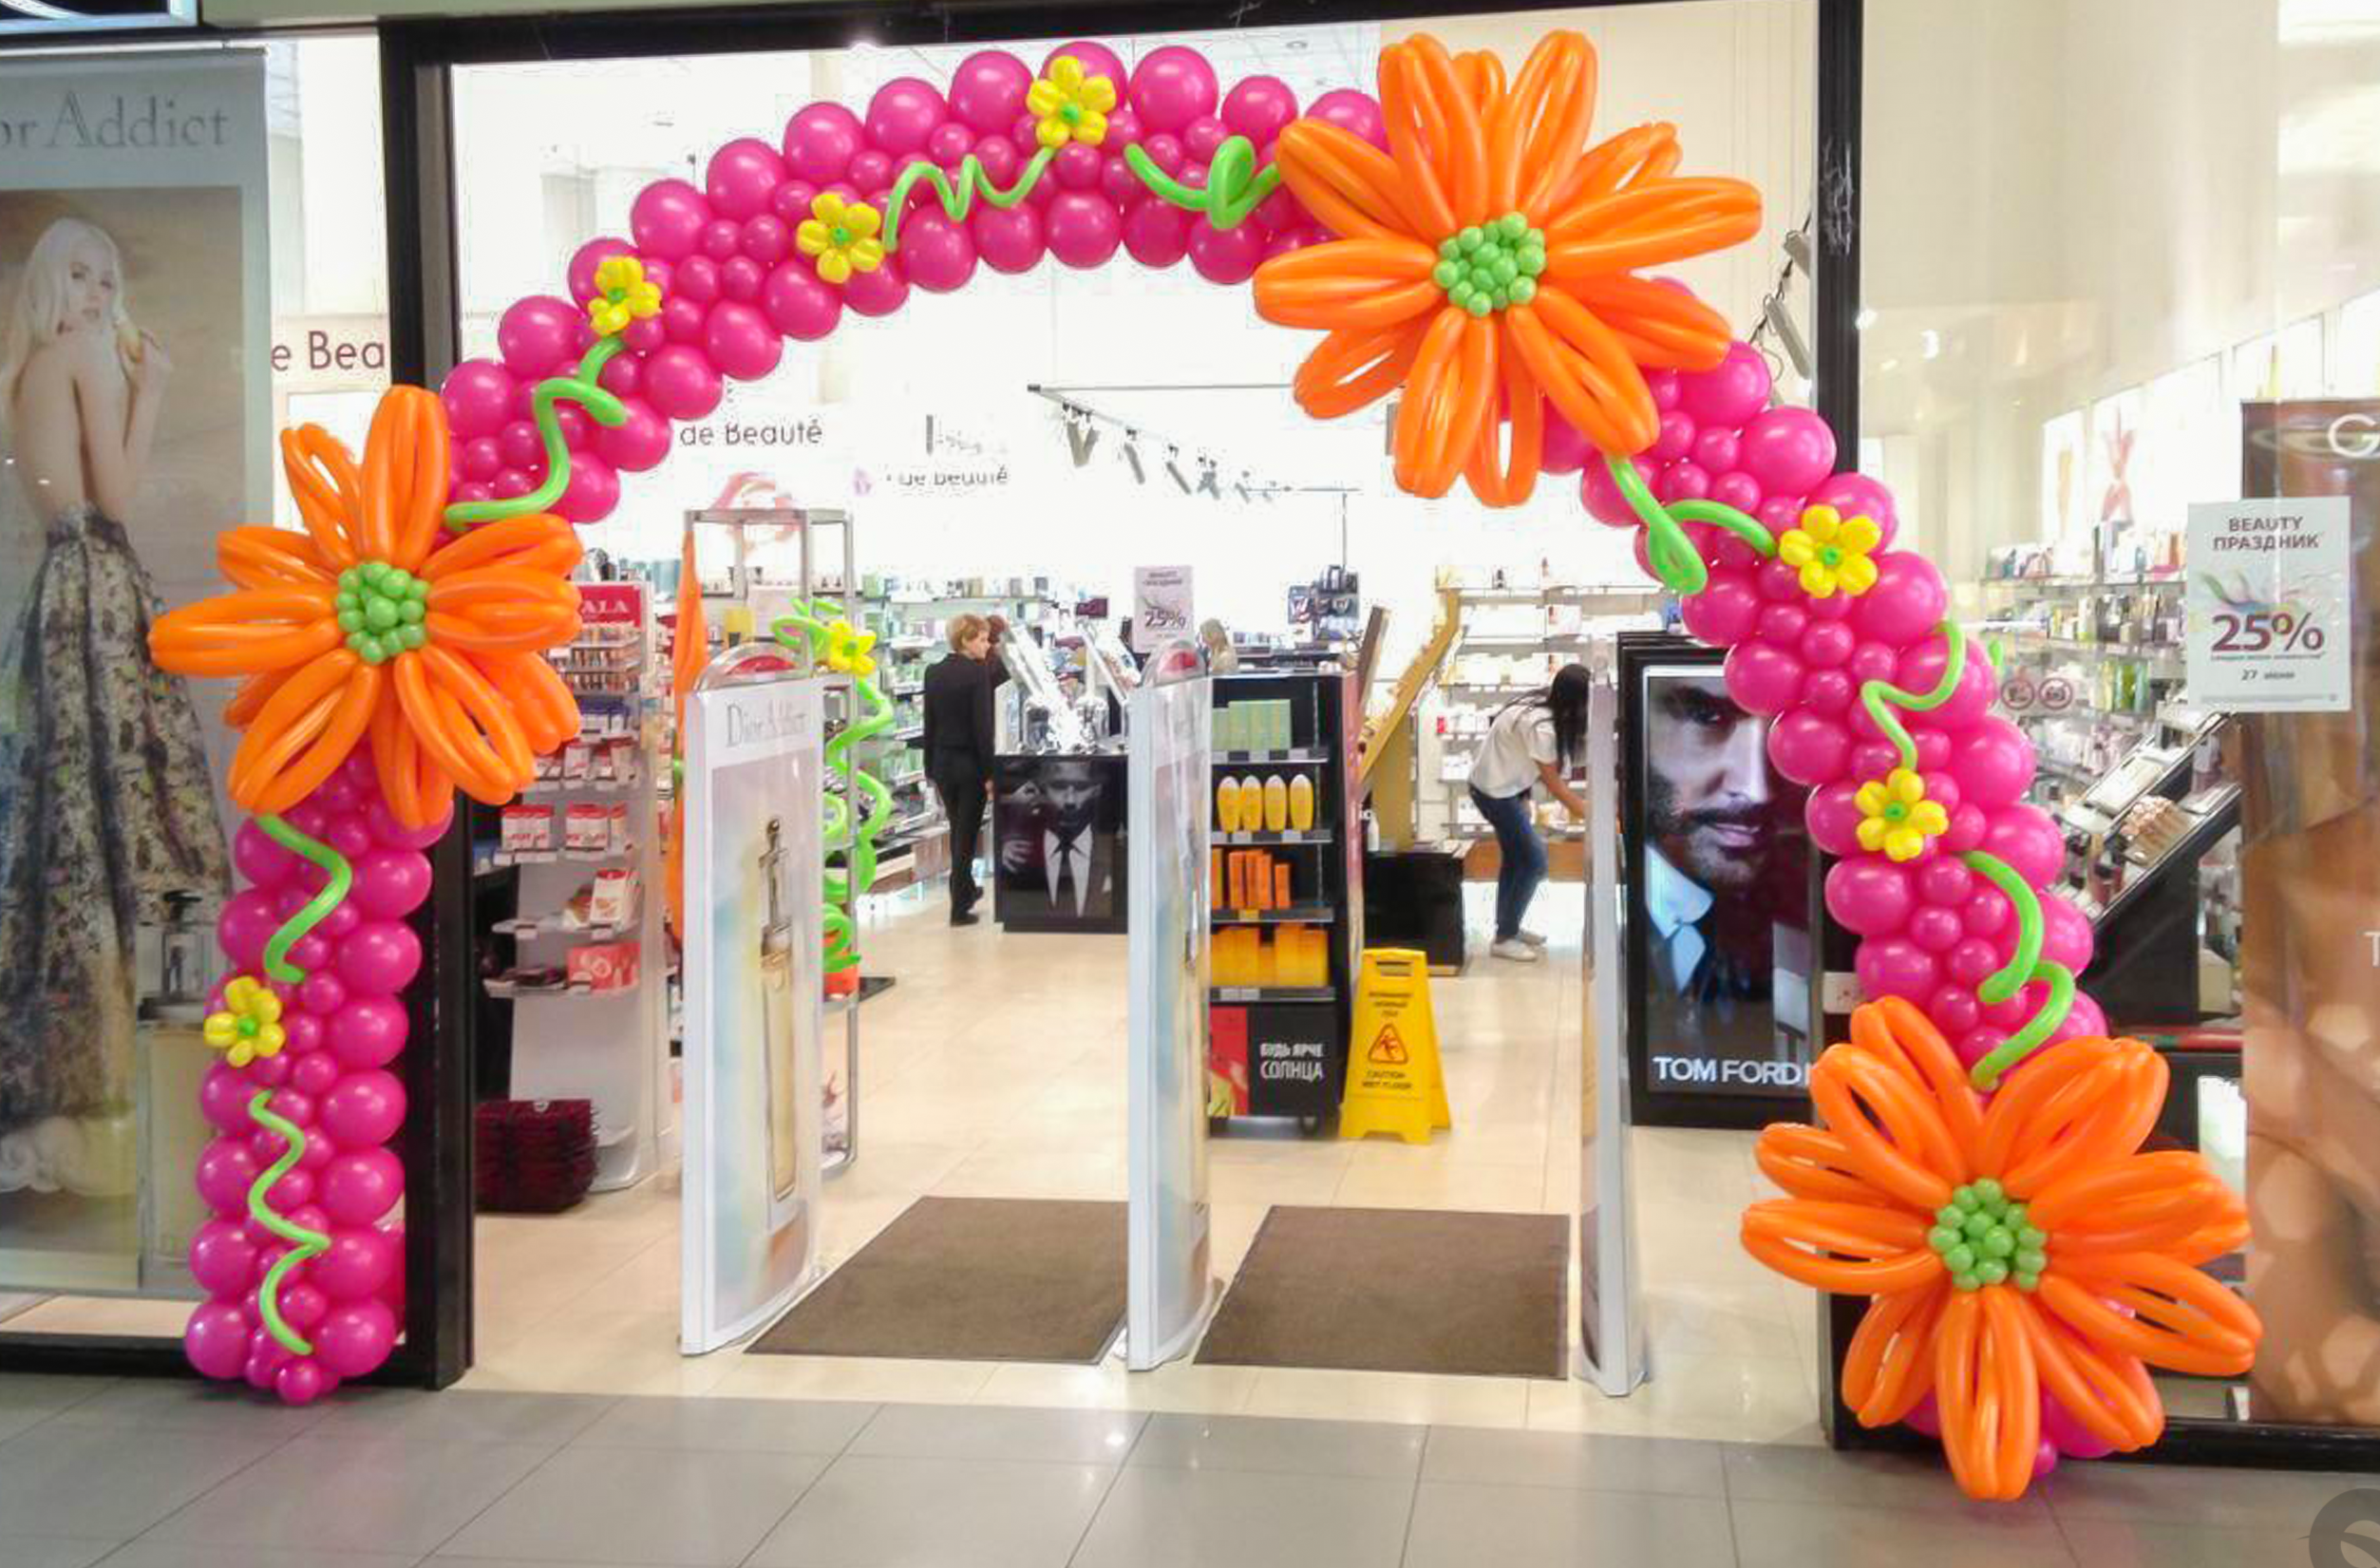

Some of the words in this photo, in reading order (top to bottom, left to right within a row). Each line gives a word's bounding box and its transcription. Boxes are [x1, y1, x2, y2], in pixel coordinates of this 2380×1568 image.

[46, 91, 228, 147] Addict
[680, 425, 713, 445] de
[2228, 516, 2304, 532] BEAUTY
[2213, 534, 2319, 552] ПРАЗДНИК
[2211, 612, 2325, 652] 25%
[1259, 1060, 1324, 1084] СОЛНЦА
[1653, 1056, 1717, 1083] TOM
[1721, 1060, 1803, 1086] FORD
